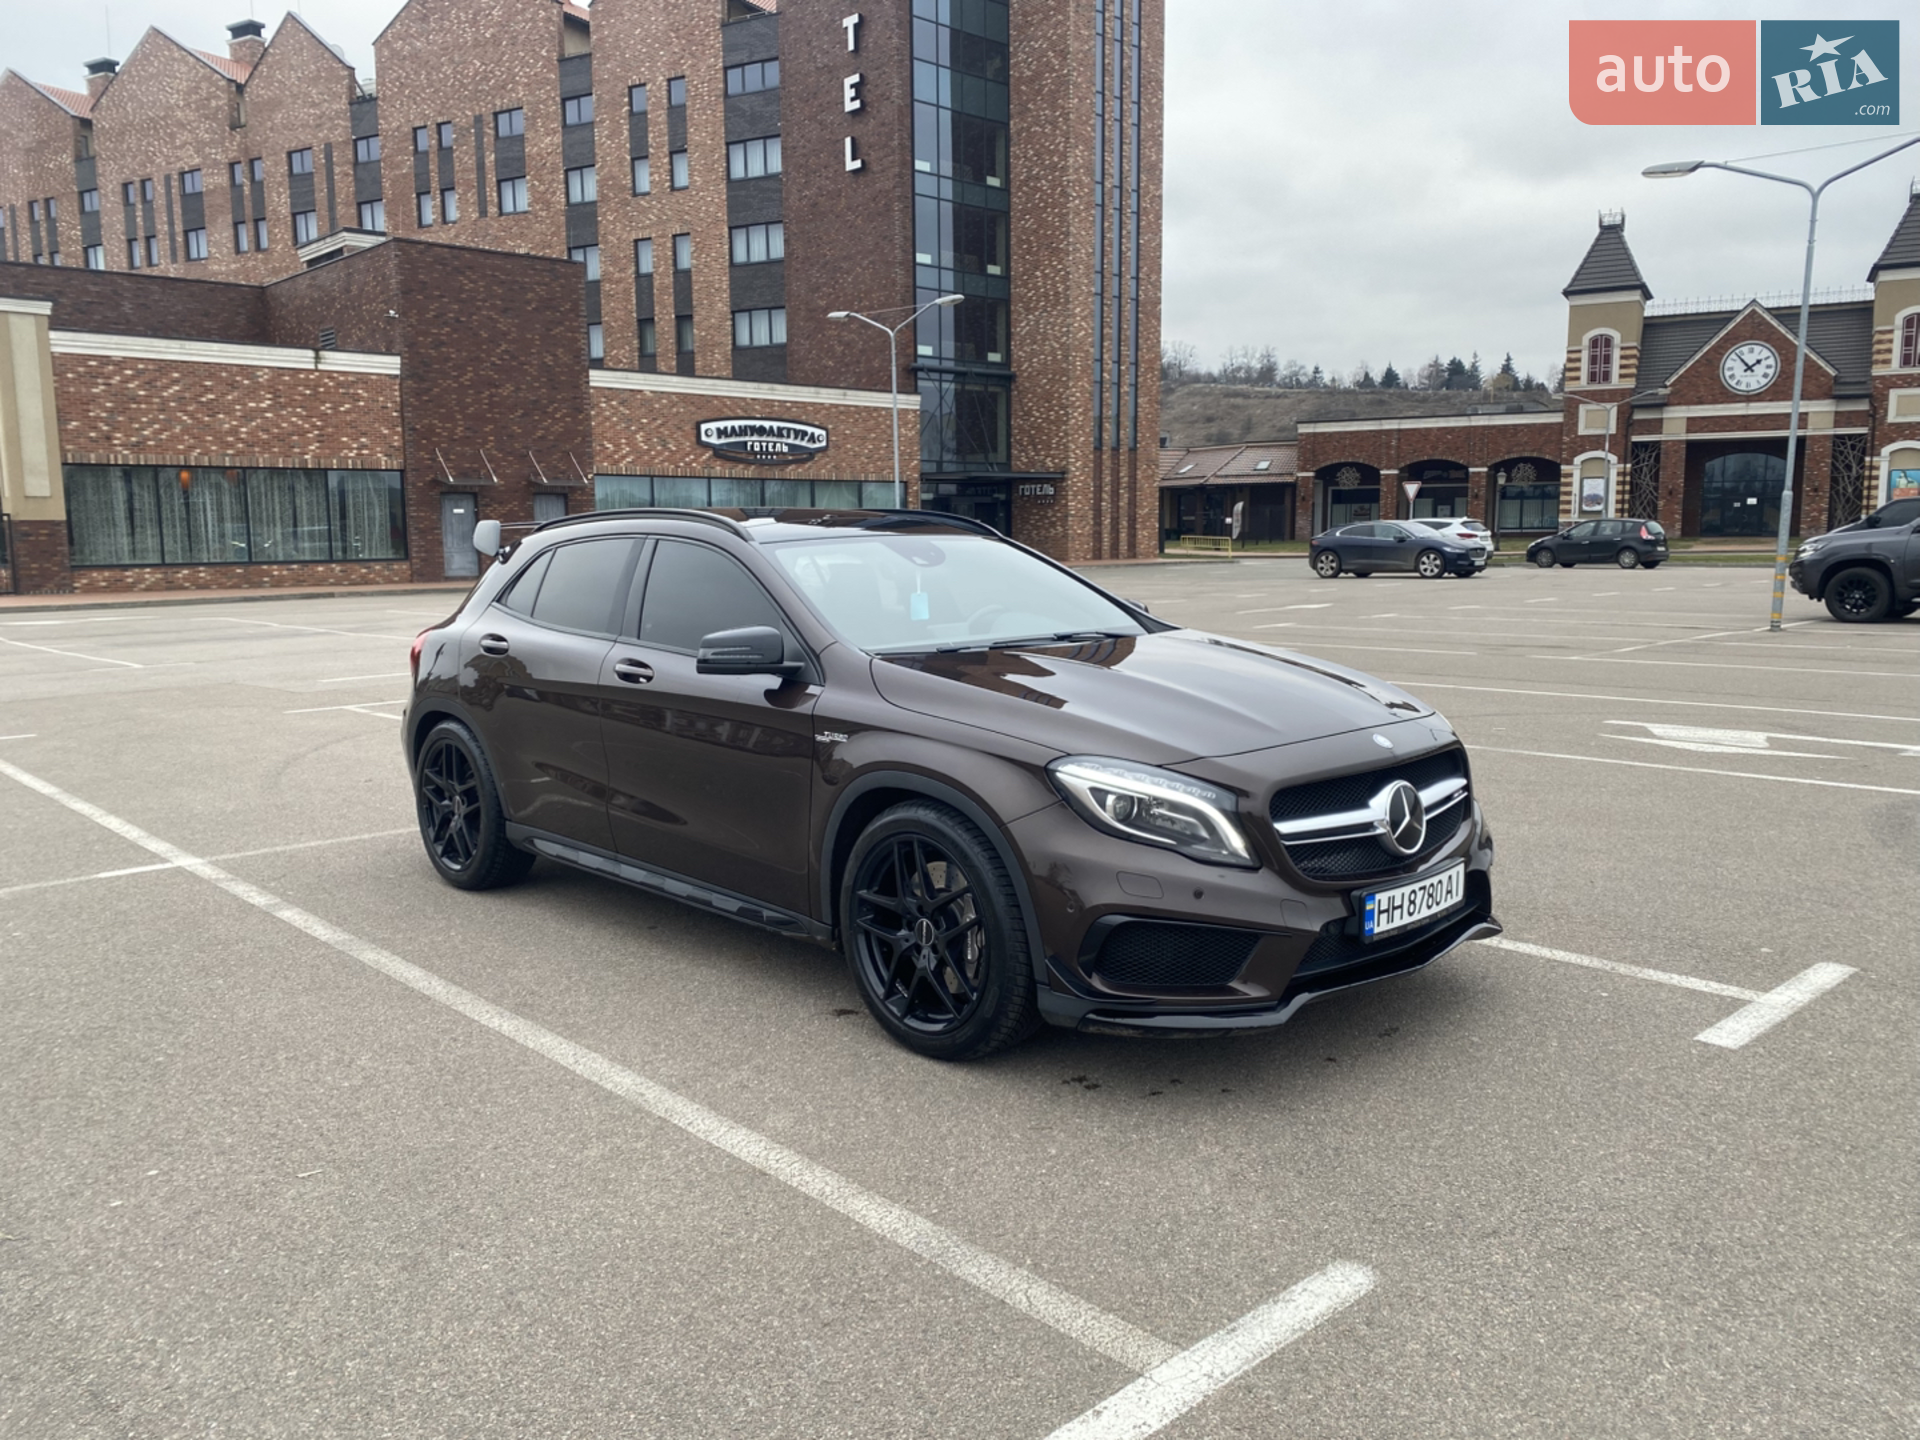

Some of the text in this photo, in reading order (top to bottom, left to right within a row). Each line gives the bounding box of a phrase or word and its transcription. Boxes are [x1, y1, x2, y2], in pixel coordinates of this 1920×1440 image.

[842, 12, 862, 172] TEL
[715, 424, 817, 444] МАНУФАКТУРА
[747, 441, 789, 452] ГОТЕЛЬ
[1019, 484, 1055, 496] ГОТЕЛЬ
[1364, 919, 1374, 931] UA
